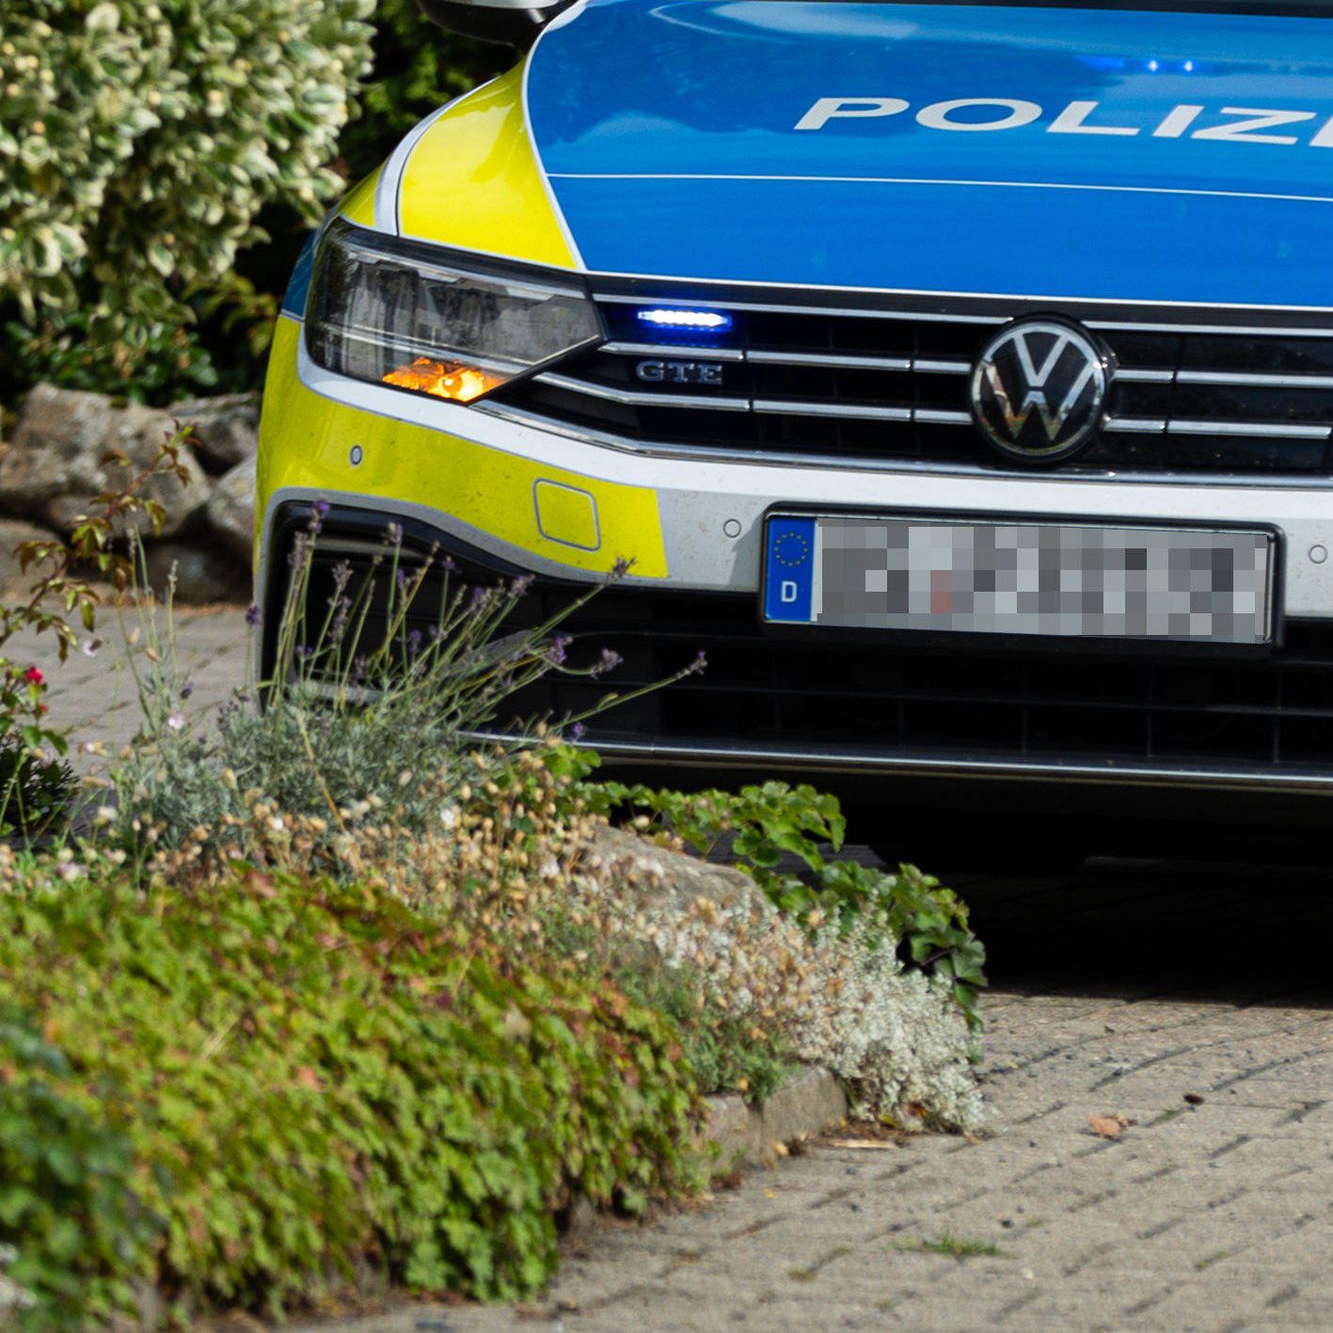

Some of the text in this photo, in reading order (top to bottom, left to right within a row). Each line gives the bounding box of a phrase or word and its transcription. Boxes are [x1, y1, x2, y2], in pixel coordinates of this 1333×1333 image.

[636, 360, 723, 385] GTE
[983, 327, 1099, 443] VW
[781, 580, 798, 602] D
